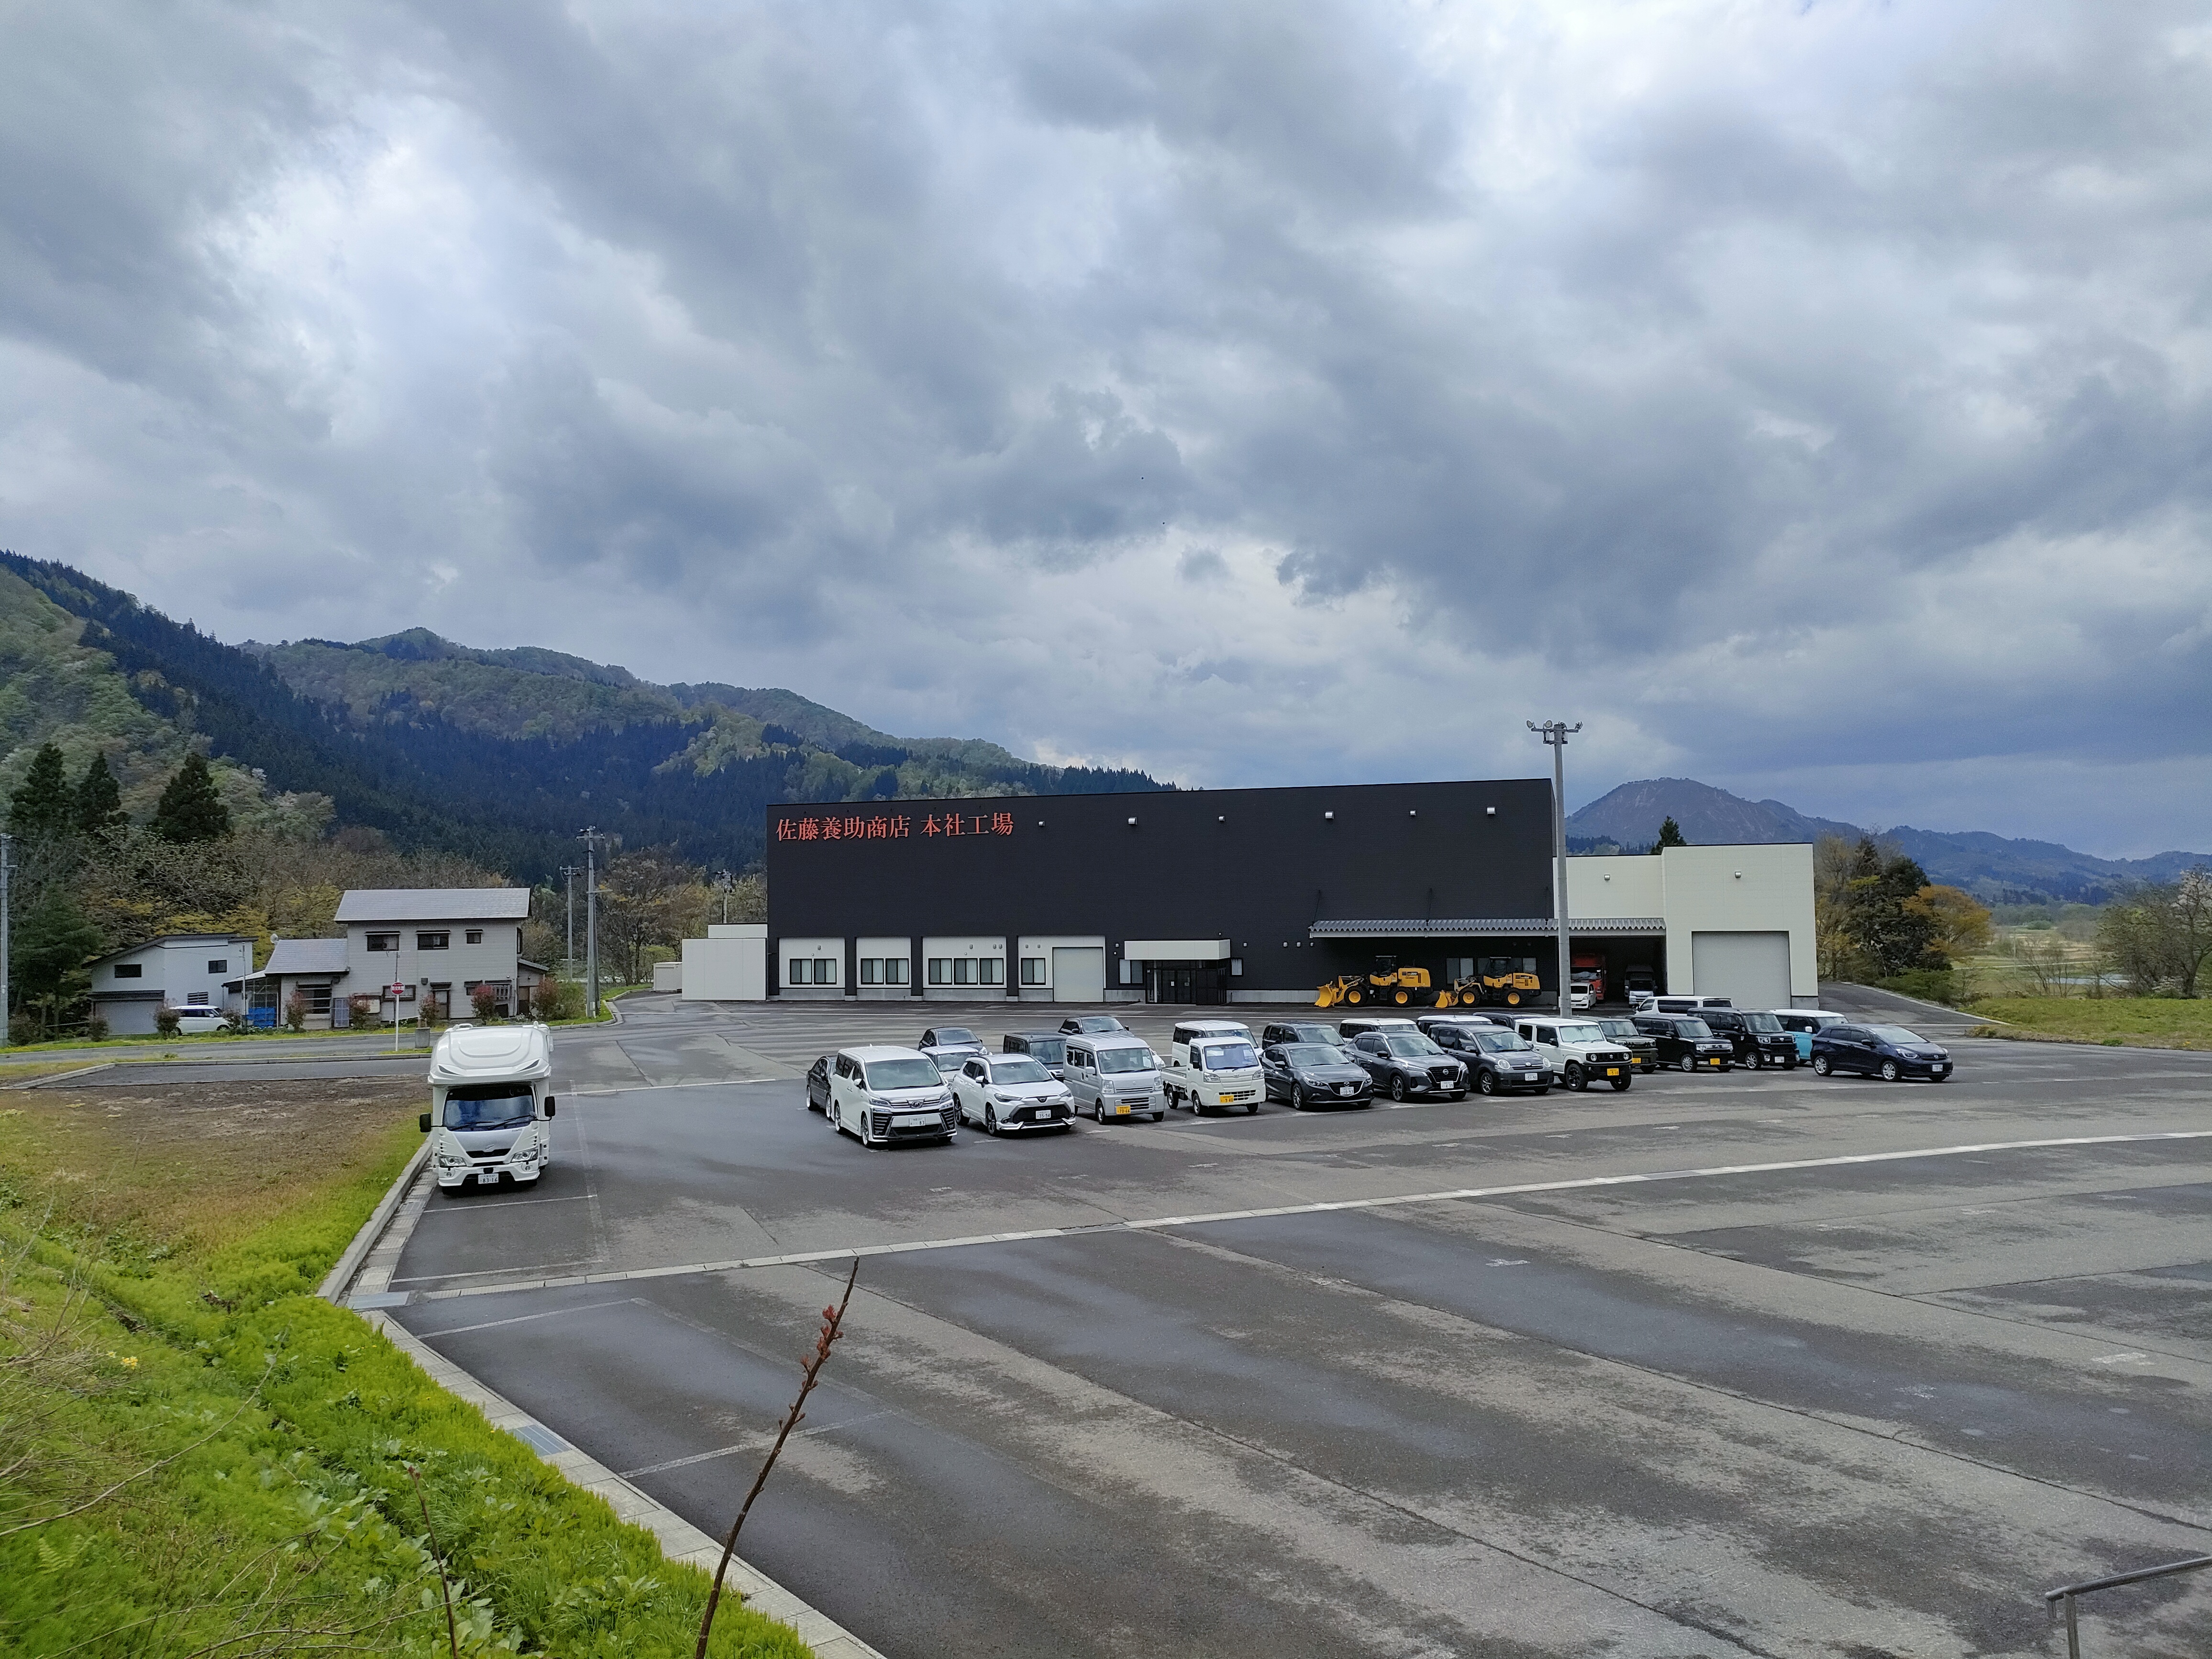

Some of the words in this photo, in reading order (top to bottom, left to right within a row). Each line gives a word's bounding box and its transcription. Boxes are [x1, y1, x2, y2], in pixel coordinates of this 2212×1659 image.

[776, 815, 911, 841] 佐藤養助商店
[920, 812, 1014, 837] 本社工場
